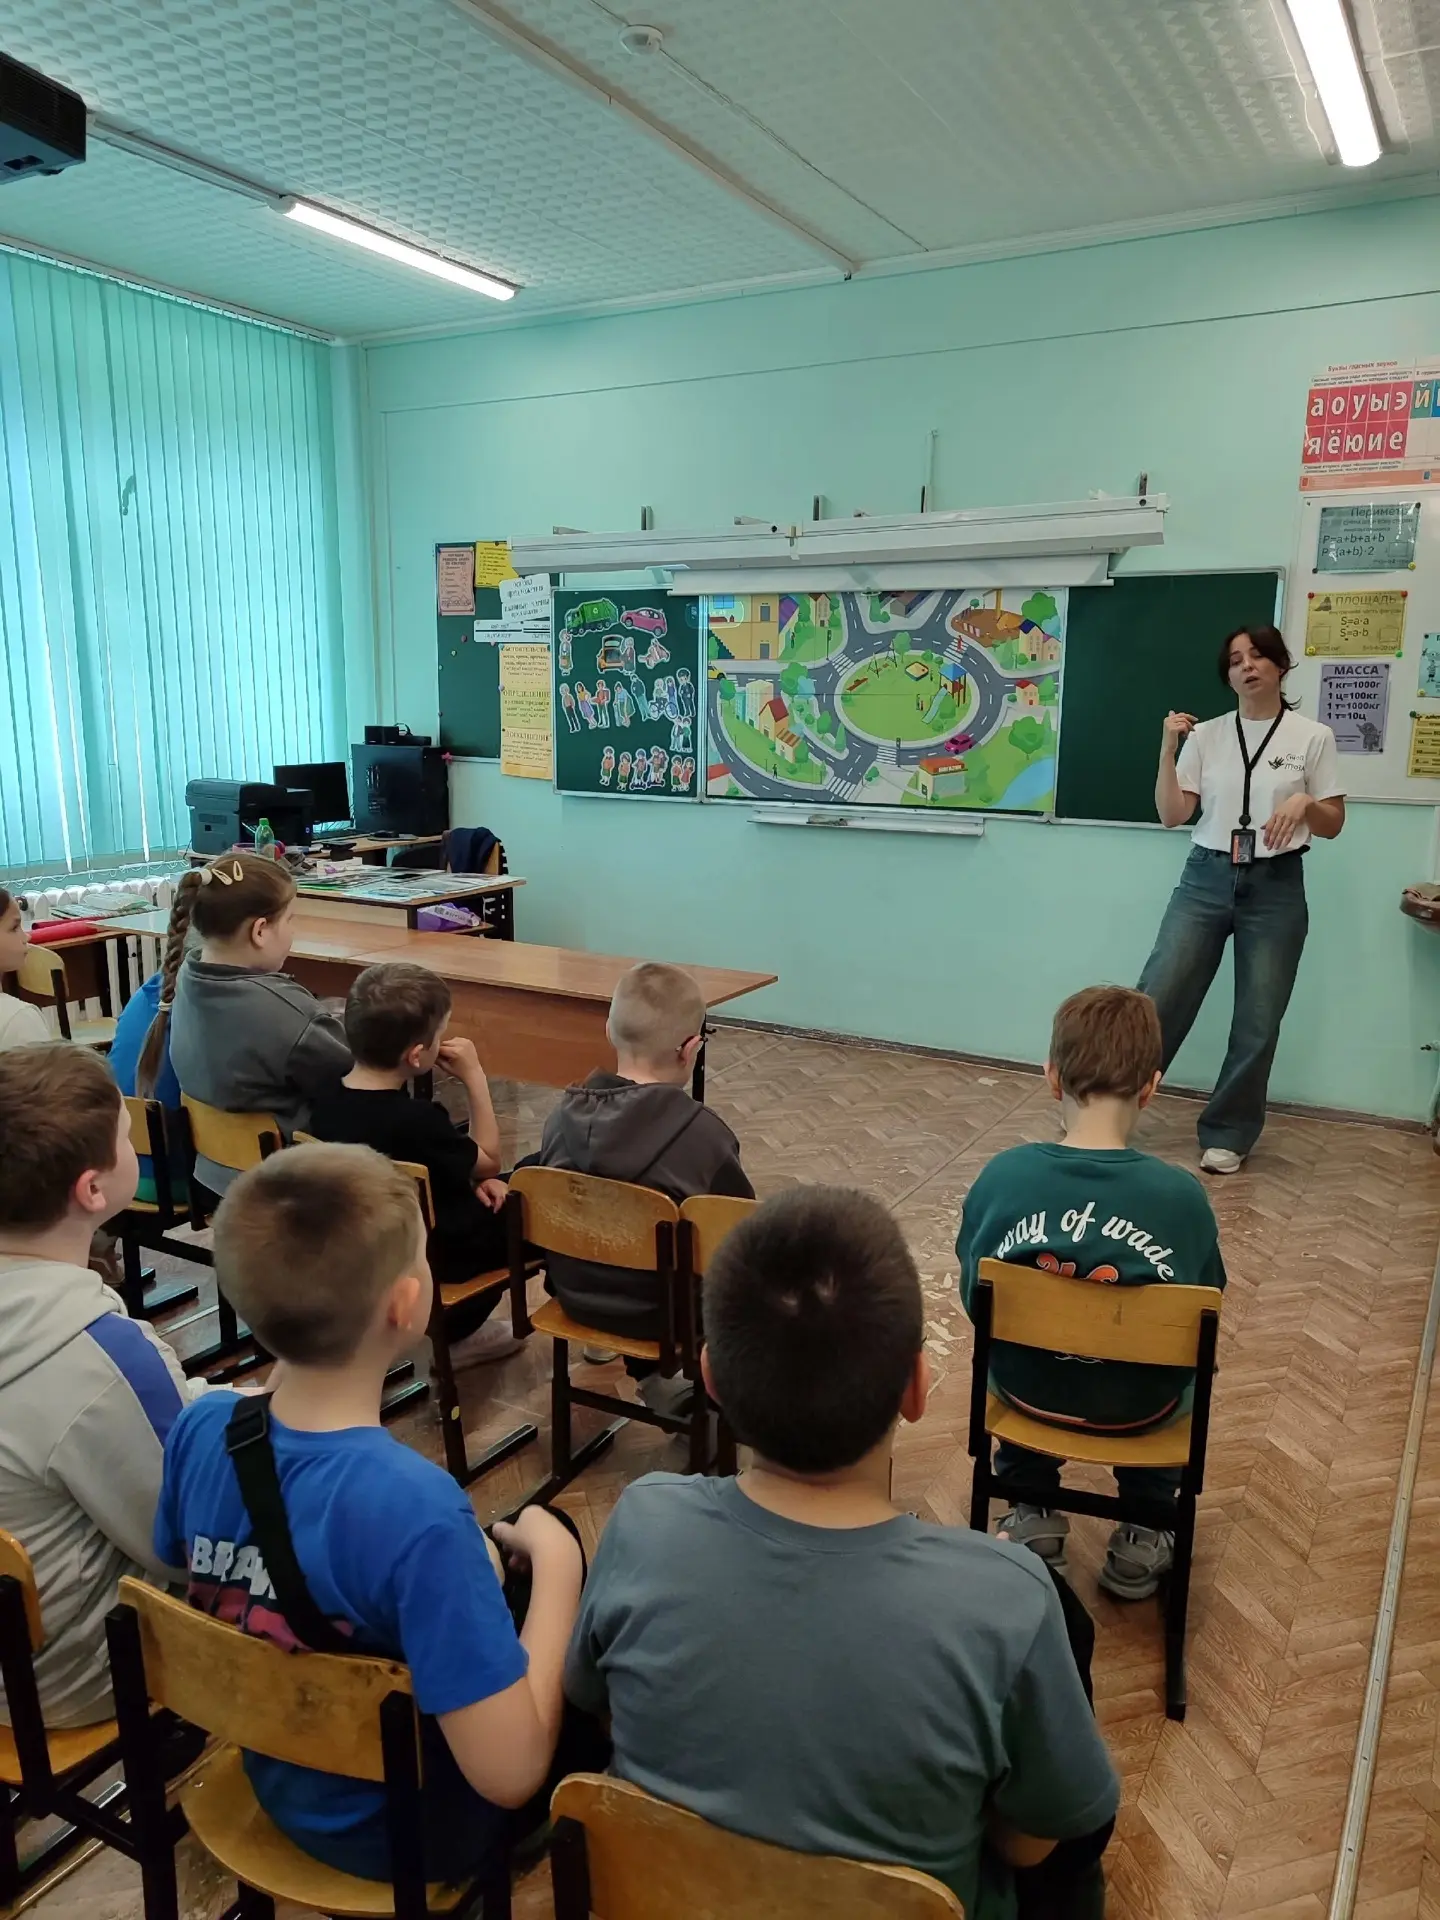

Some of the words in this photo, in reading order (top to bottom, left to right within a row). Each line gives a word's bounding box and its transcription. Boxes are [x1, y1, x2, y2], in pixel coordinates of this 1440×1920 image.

[1336, 595, 1397, 606] ПЛОЩАДЬ
[1334, 665, 1379, 675] МАССА
[996, 1211, 1049, 1259] way
[1060, 1201, 1096, 1243] of
[1101, 1215, 1175, 1281] wade
